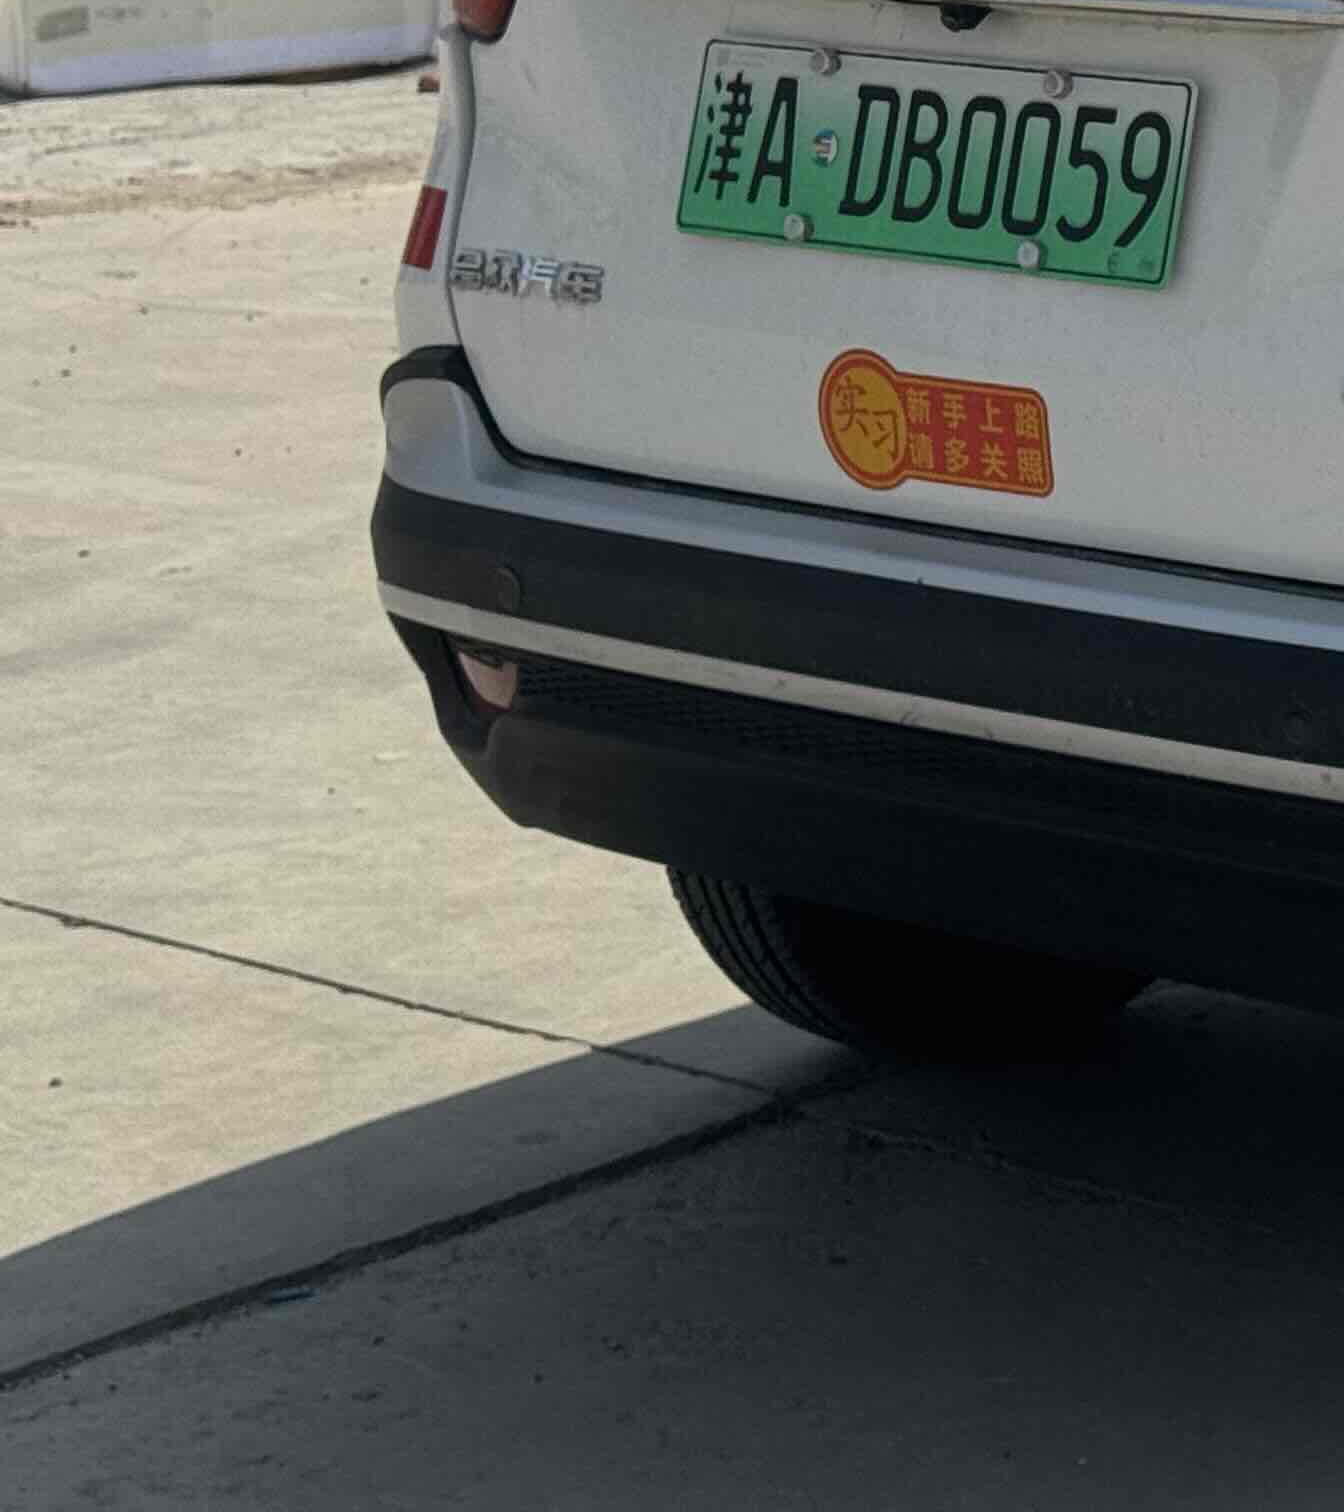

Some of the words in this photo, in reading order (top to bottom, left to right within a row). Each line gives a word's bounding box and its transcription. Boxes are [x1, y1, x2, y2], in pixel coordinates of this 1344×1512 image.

[831, 373, 900, 463] 实习
[904, 386, 1041, 440] 新手上路
